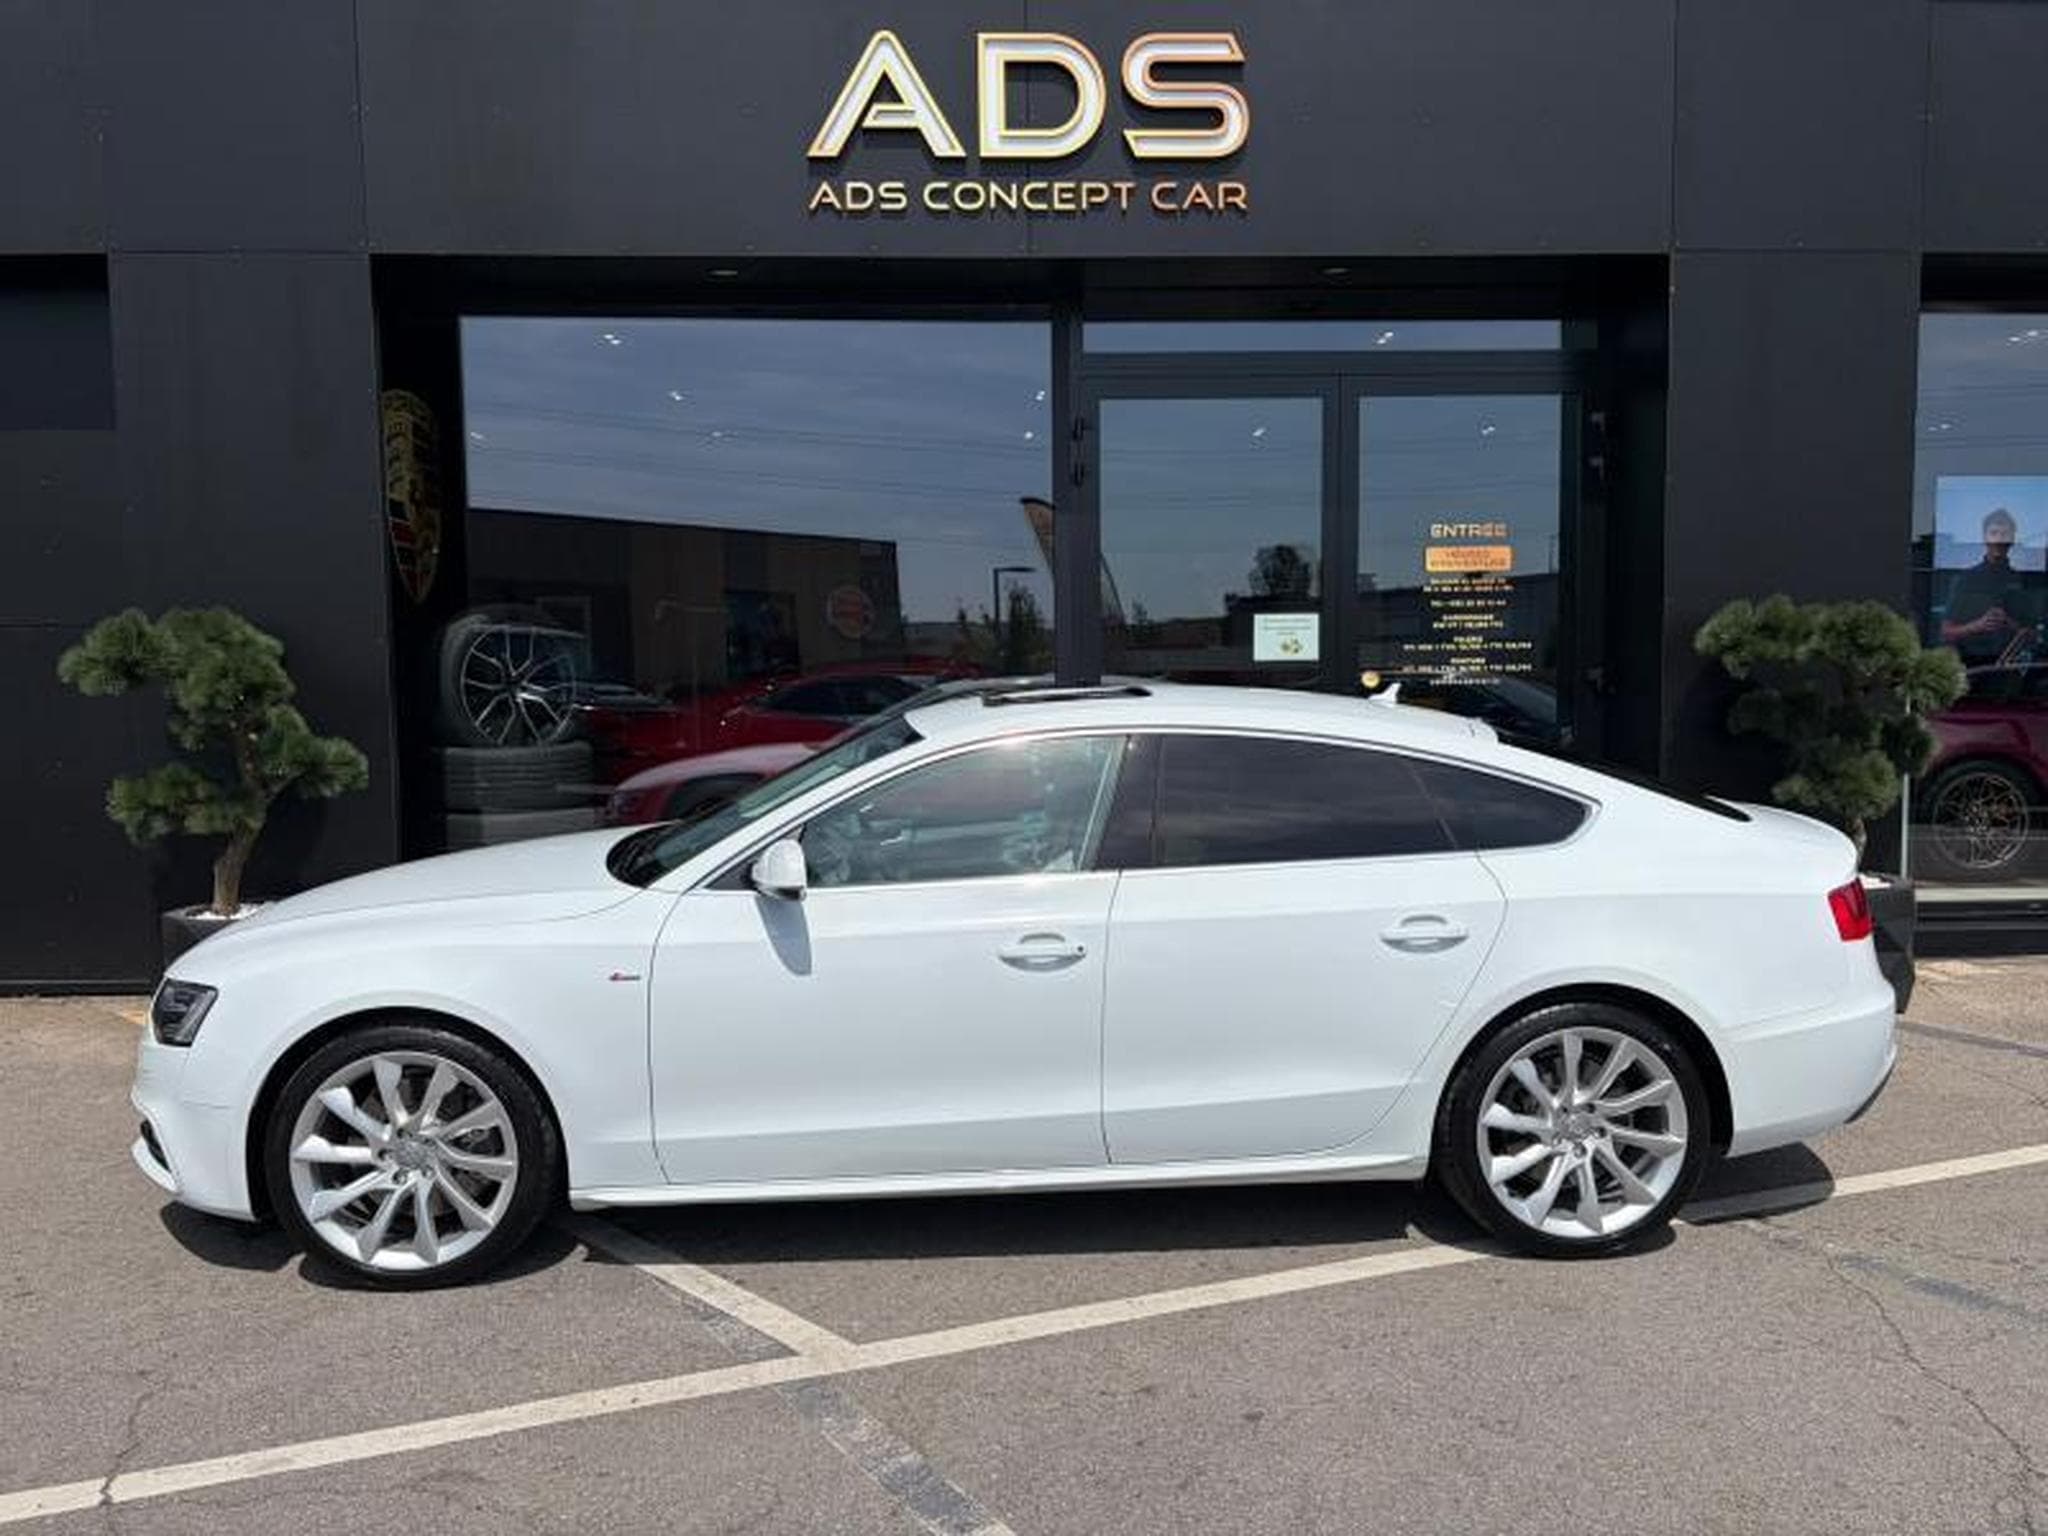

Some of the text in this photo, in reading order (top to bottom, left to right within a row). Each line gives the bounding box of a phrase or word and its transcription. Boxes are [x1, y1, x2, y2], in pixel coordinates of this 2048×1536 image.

[807, 29, 1250, 158] ADS
[809, 181, 1248, 211] ADS CONCEPT CAR
